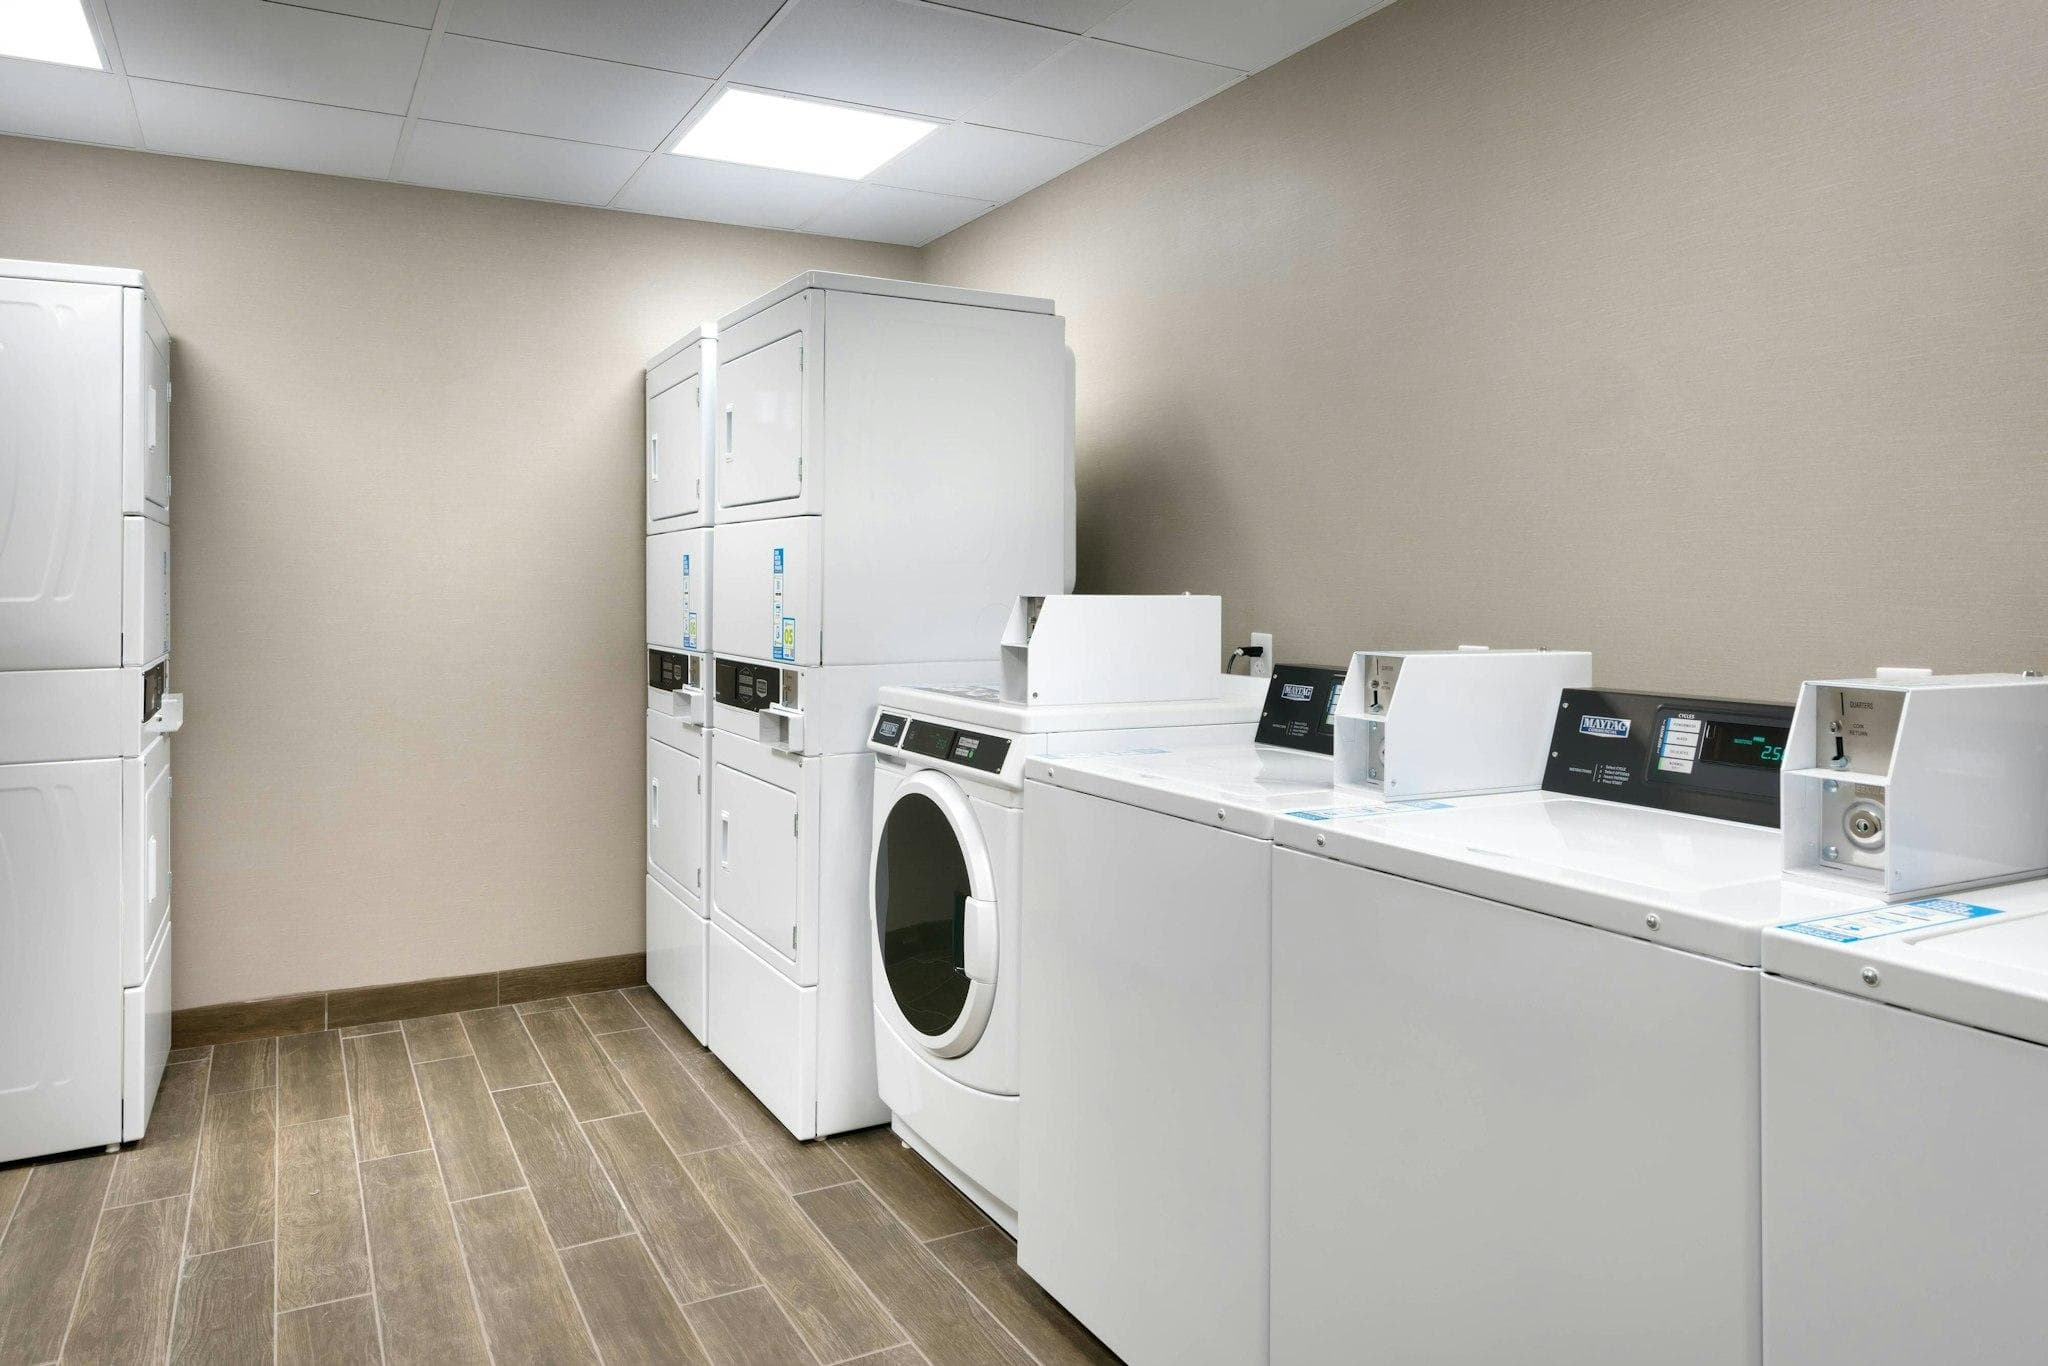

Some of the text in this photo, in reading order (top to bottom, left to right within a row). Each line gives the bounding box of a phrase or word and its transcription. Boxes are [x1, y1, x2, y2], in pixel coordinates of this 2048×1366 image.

[1284, 686, 1312, 697] MAYTAG
[1583, 718, 1626, 732] MAYTAG
[1761, 745, 1784, 761] 25
